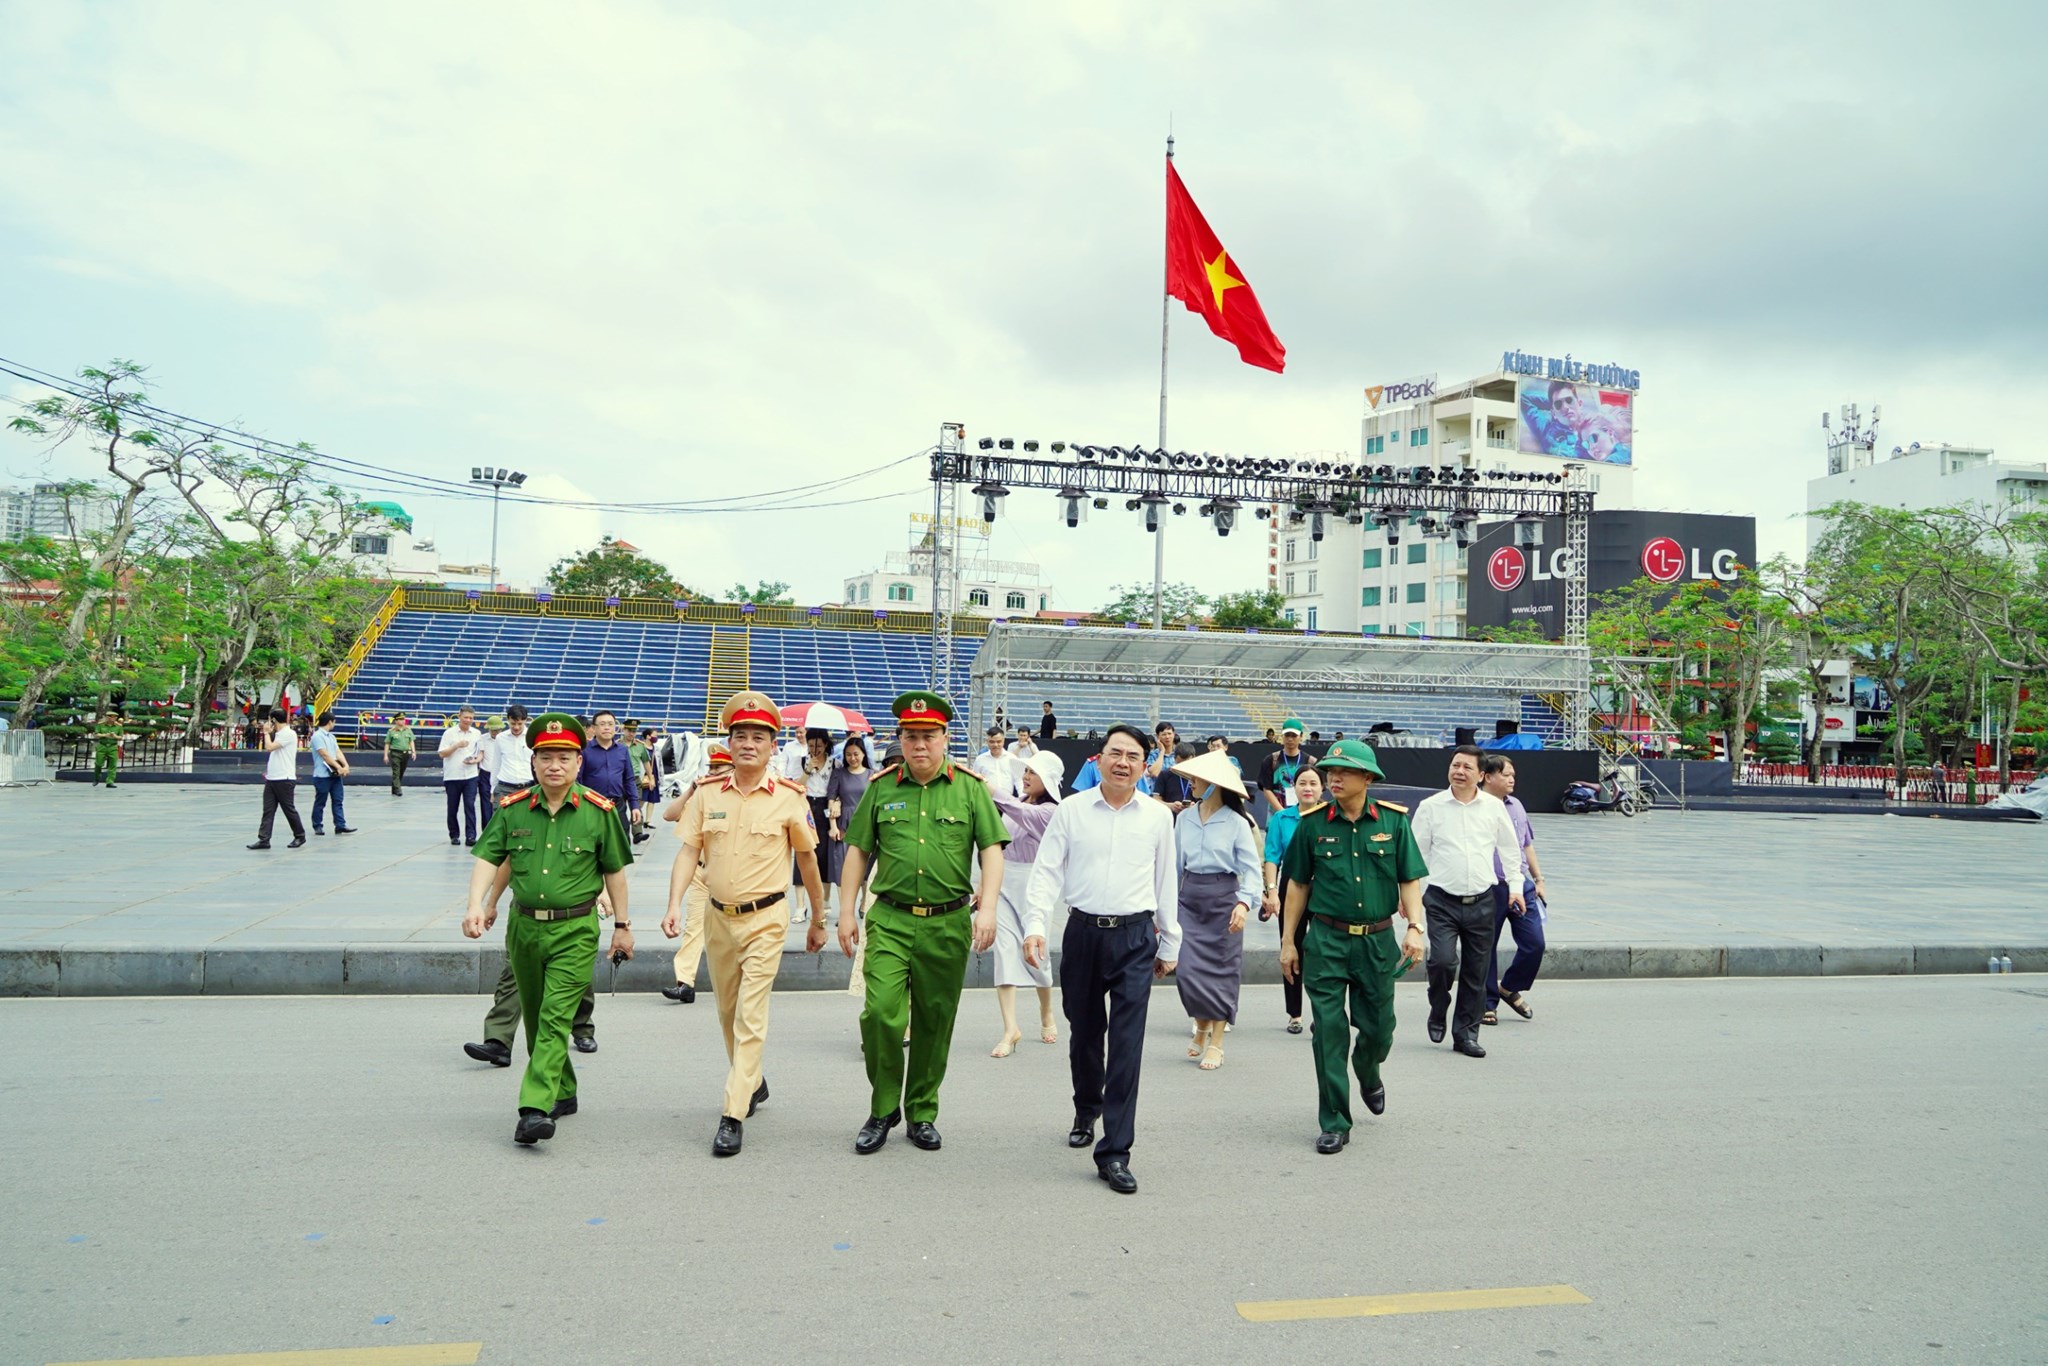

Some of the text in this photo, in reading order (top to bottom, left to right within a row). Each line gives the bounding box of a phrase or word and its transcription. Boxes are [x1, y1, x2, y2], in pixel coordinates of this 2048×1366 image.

[1504, 349, 1544, 375] KÍNH
[1549, 353, 1582, 382] MẮT
[1384, 379, 1436, 404] TPBank
[1532, 547, 1575, 581] LG
[1691, 548, 1738, 581] LG
[1511, 604, 1554, 615] www.lg.com
